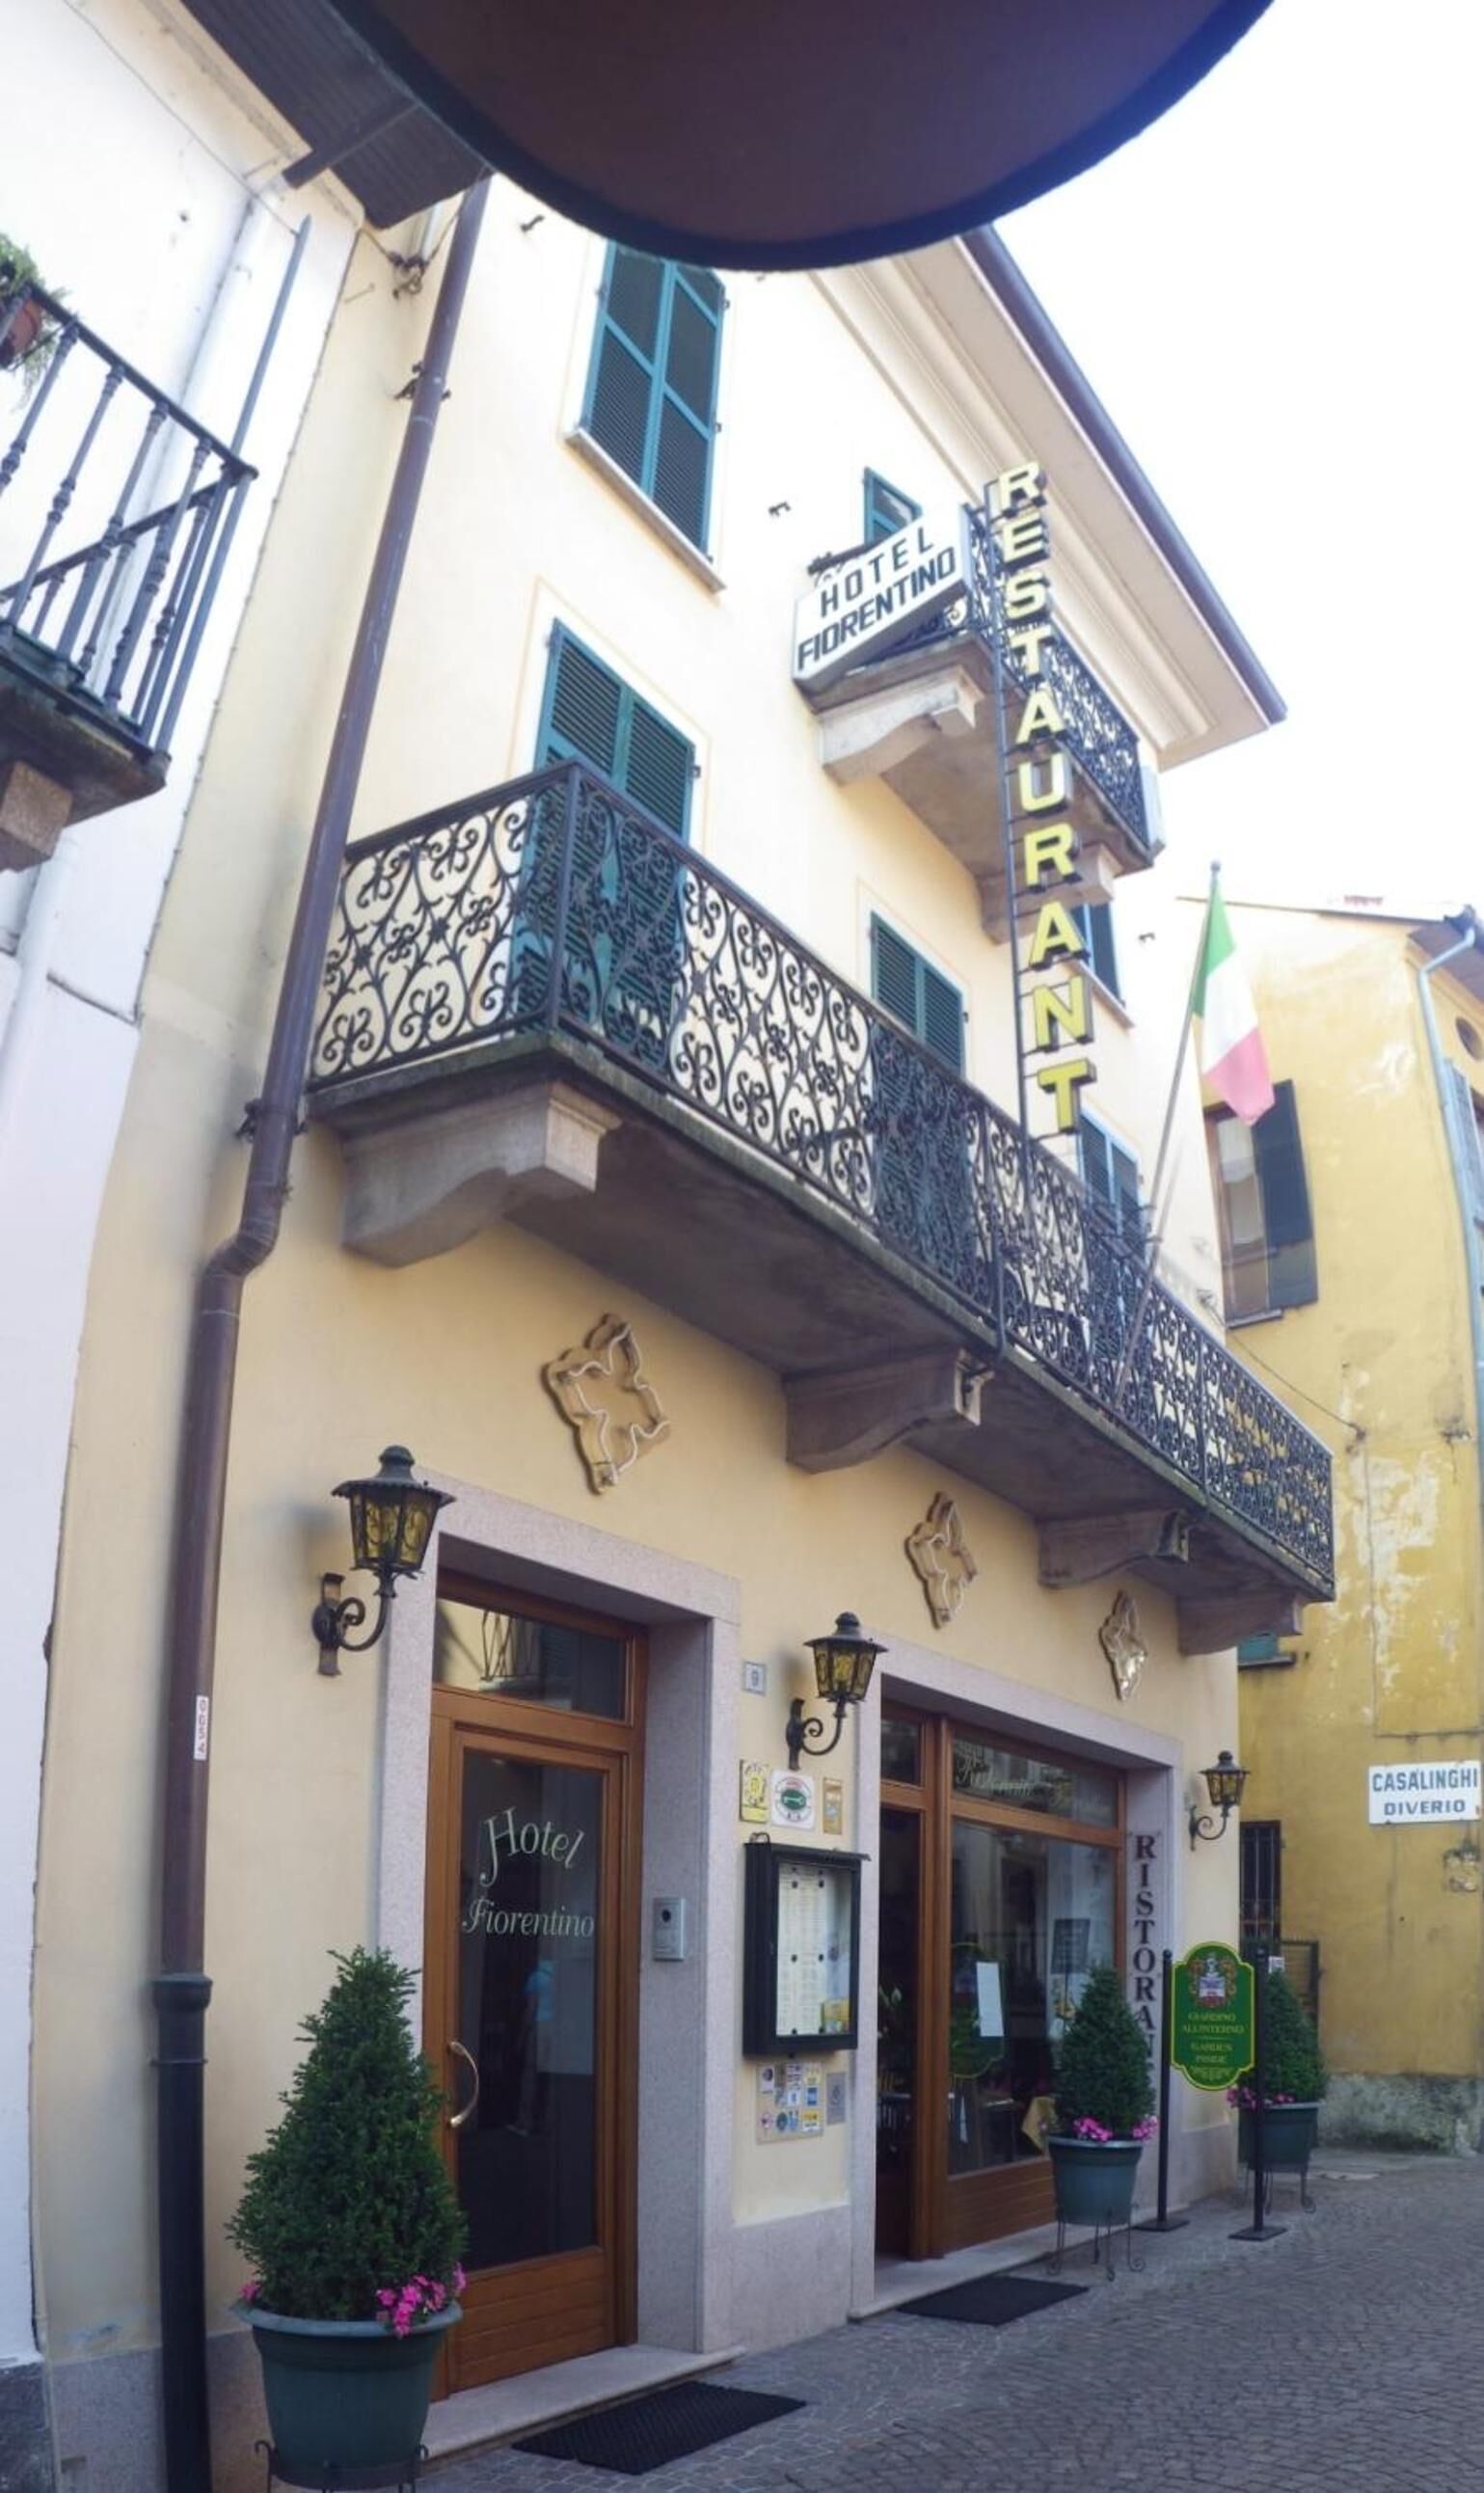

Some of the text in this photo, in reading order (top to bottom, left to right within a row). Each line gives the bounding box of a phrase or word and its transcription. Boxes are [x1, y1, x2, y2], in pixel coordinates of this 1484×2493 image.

[796, 546, 956, 671] FIORENTINO
[821, 527, 933, 618] HOTEL
[997, 460, 1096, 1135] RESTAURANT
[1372, 1768, 1477, 1792] CASALINGHI
[1384, 1800, 1466, 1816] DIVERIO
[480, 1806, 585, 1887] Hotel
[462, 1893, 595, 1937] Fiorentino
[1132, 1834, 1156, 2085] RISTORA
